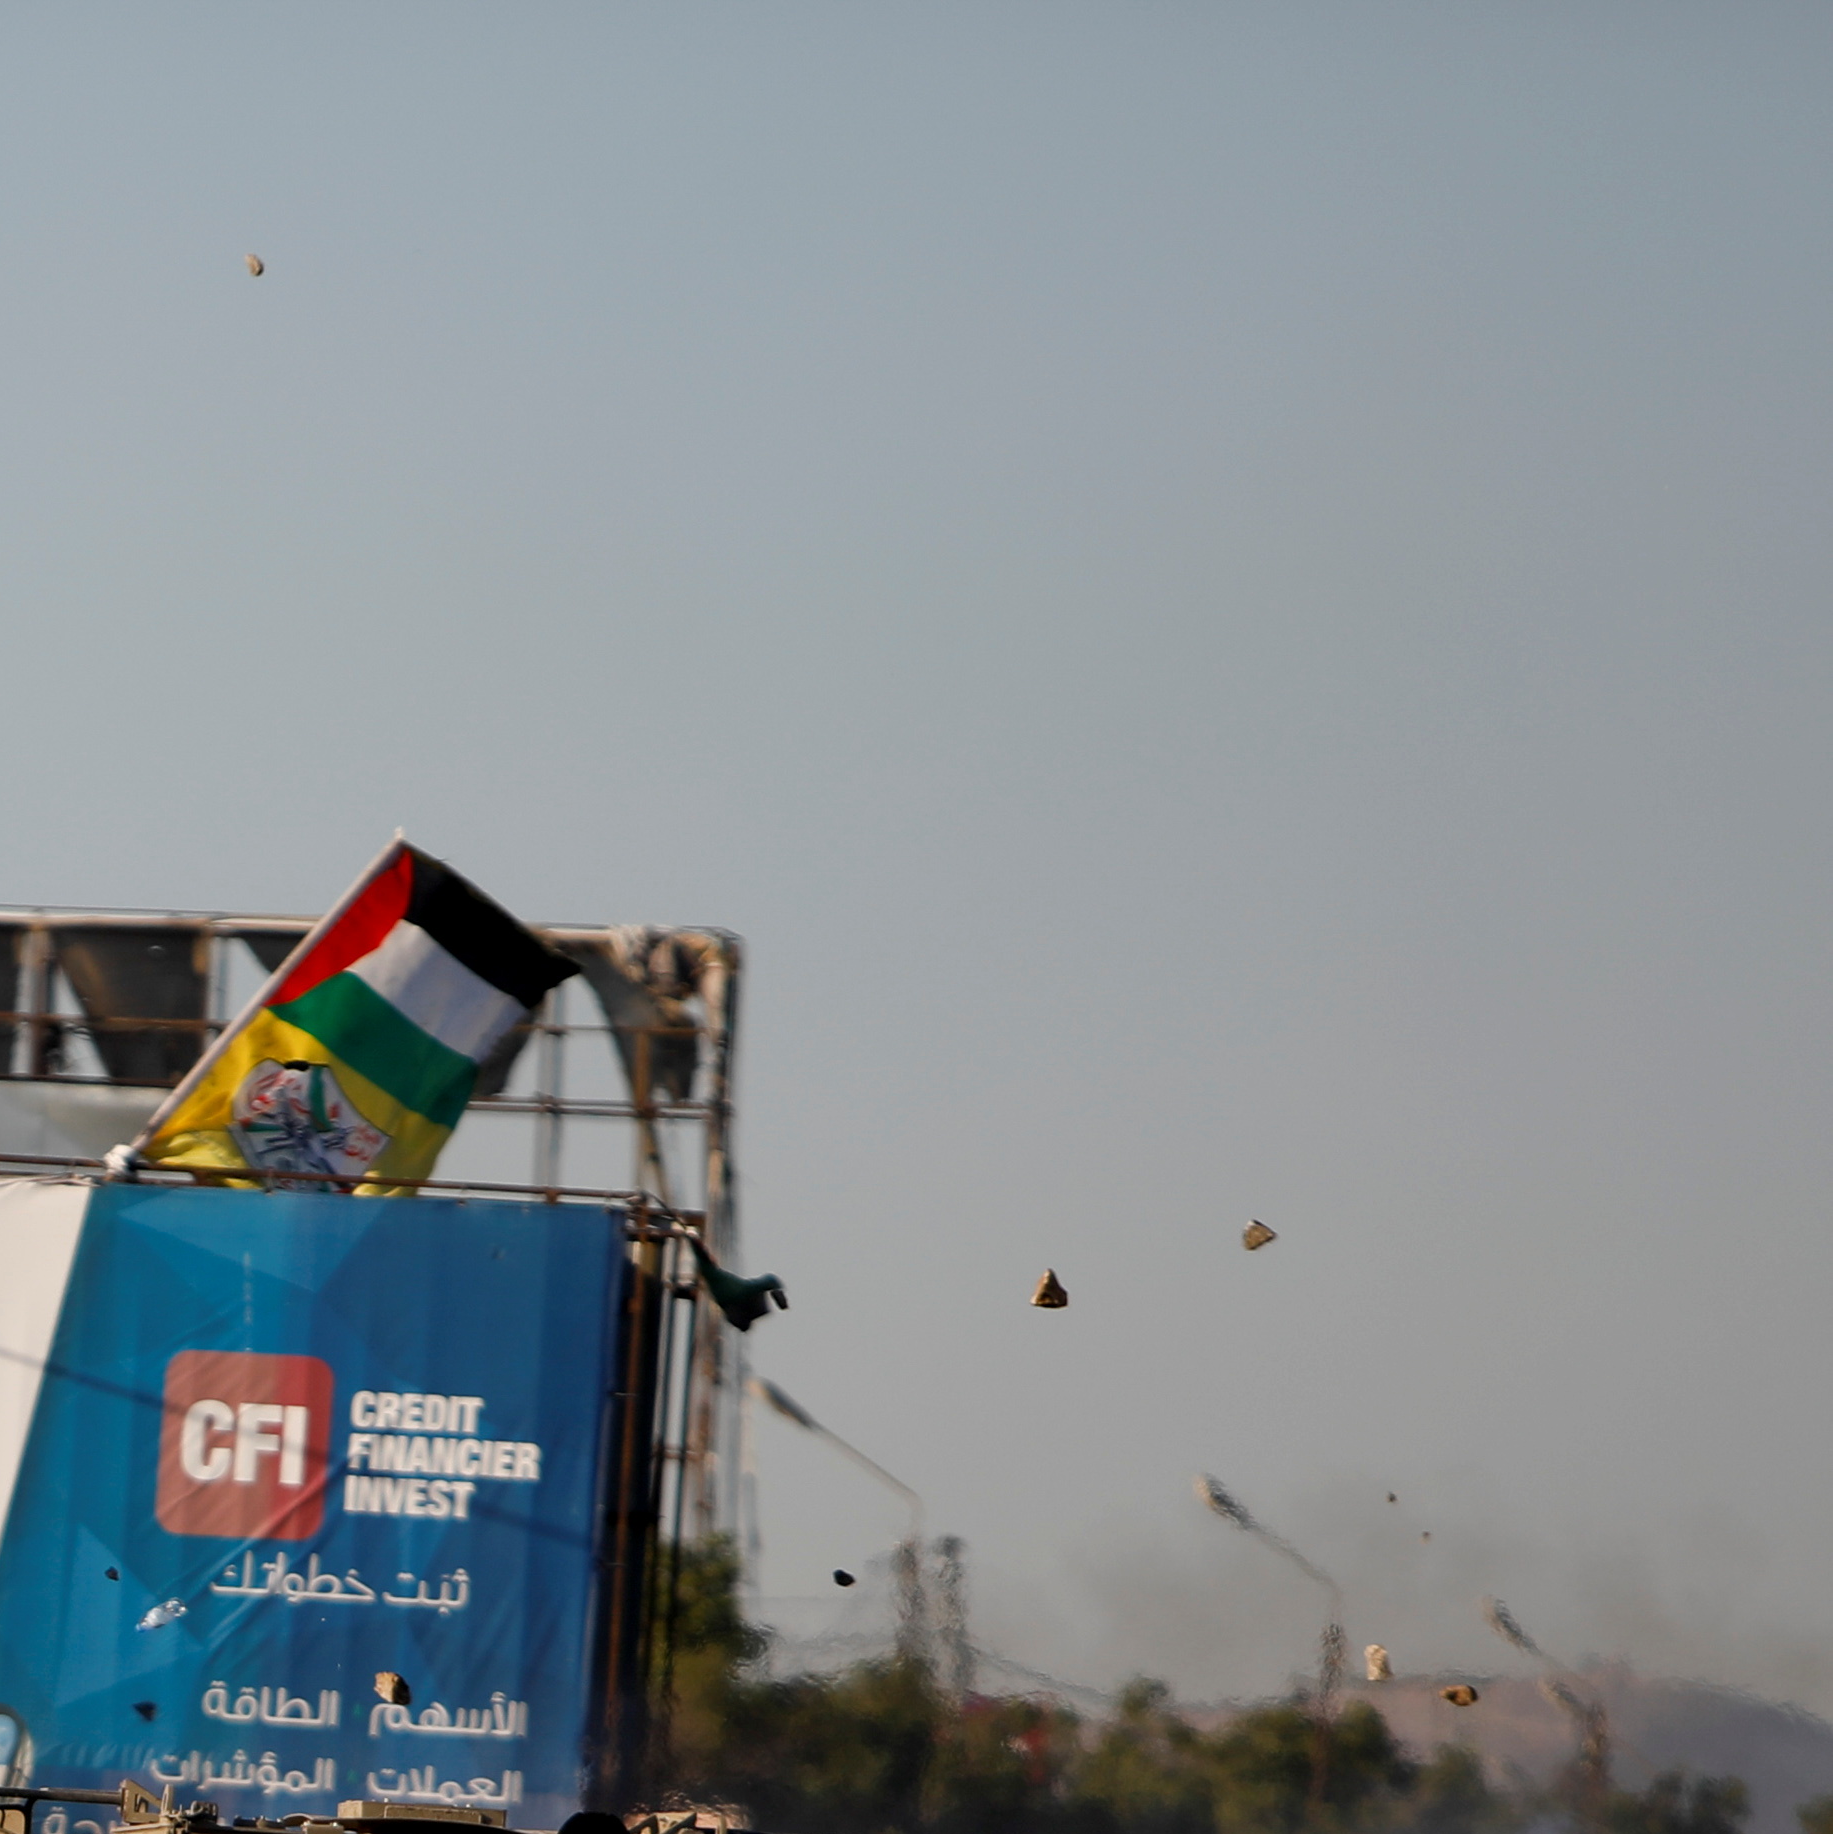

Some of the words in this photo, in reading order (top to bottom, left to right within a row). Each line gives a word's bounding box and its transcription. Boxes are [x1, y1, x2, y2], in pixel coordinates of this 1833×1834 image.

[351, 1390, 484, 1432] CREDIT
[180, 1400, 308, 1486] CFI
[348, 1434, 540, 1480] FINANCIER
[344, 1475, 475, 1519] INVEST
[209, 1549, 378, 1604] خطواتك
[202, 1680, 341, 1727] الطاقة
[369, 1691, 528, 1738] الأسهم
[151, 1749, 334, 1794] المؤشرات
[367, 1765, 524, 1803] العملات
